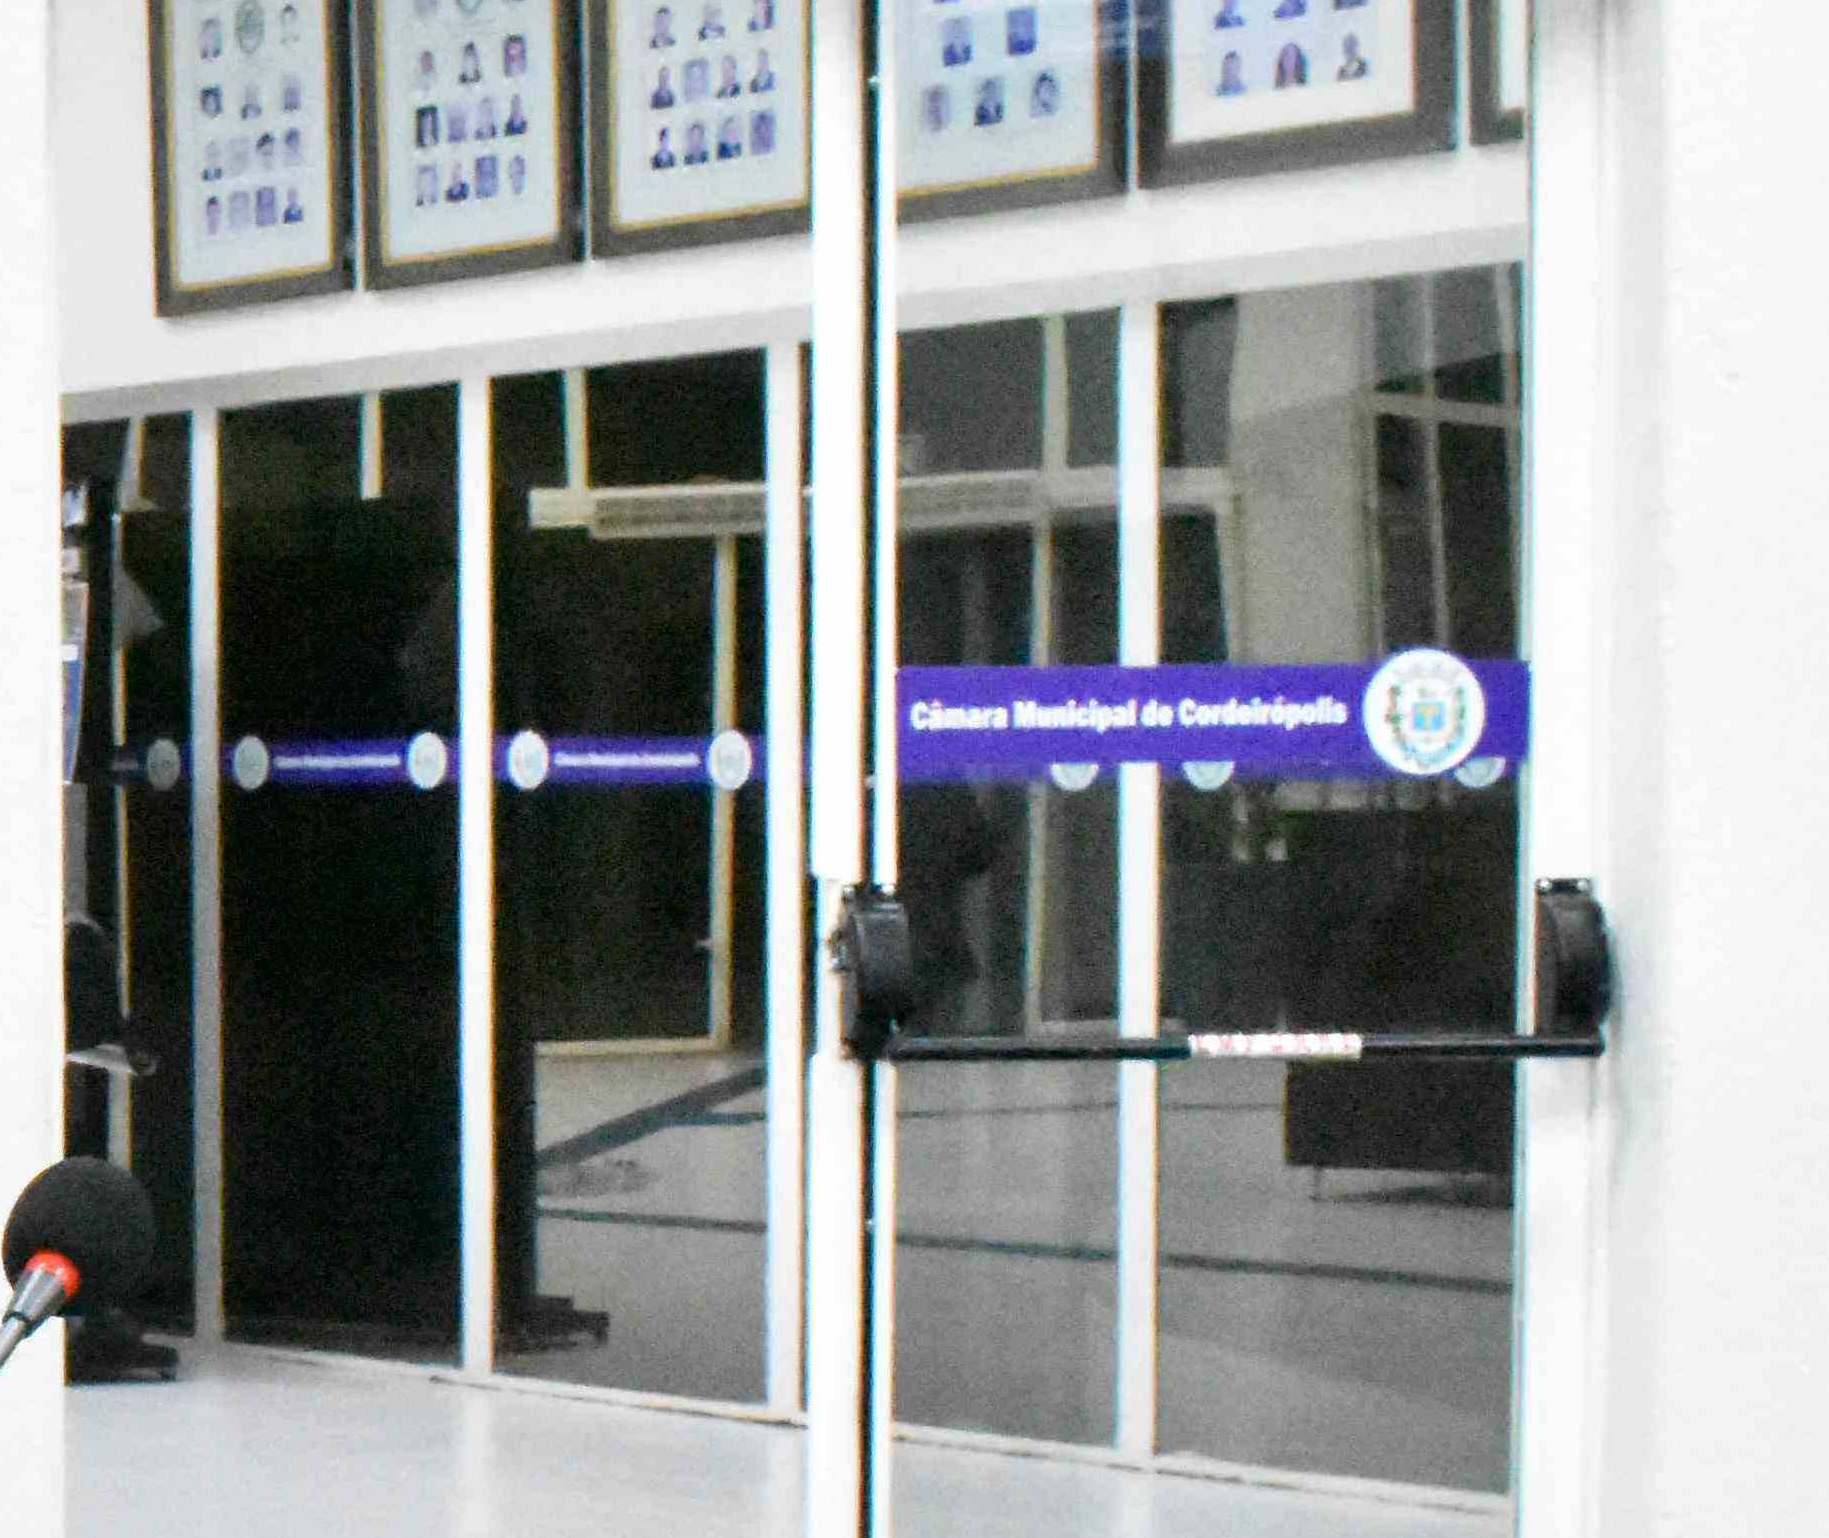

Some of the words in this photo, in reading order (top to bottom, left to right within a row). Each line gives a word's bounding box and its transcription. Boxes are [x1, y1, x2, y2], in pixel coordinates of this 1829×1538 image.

[910, 700, 1008, 730] Câmara
[1012, 698, 1137, 734] Municipal
[1141, 699, 1174, 727] de
[1177, 695, 1347, 731] Cordeirópolis
